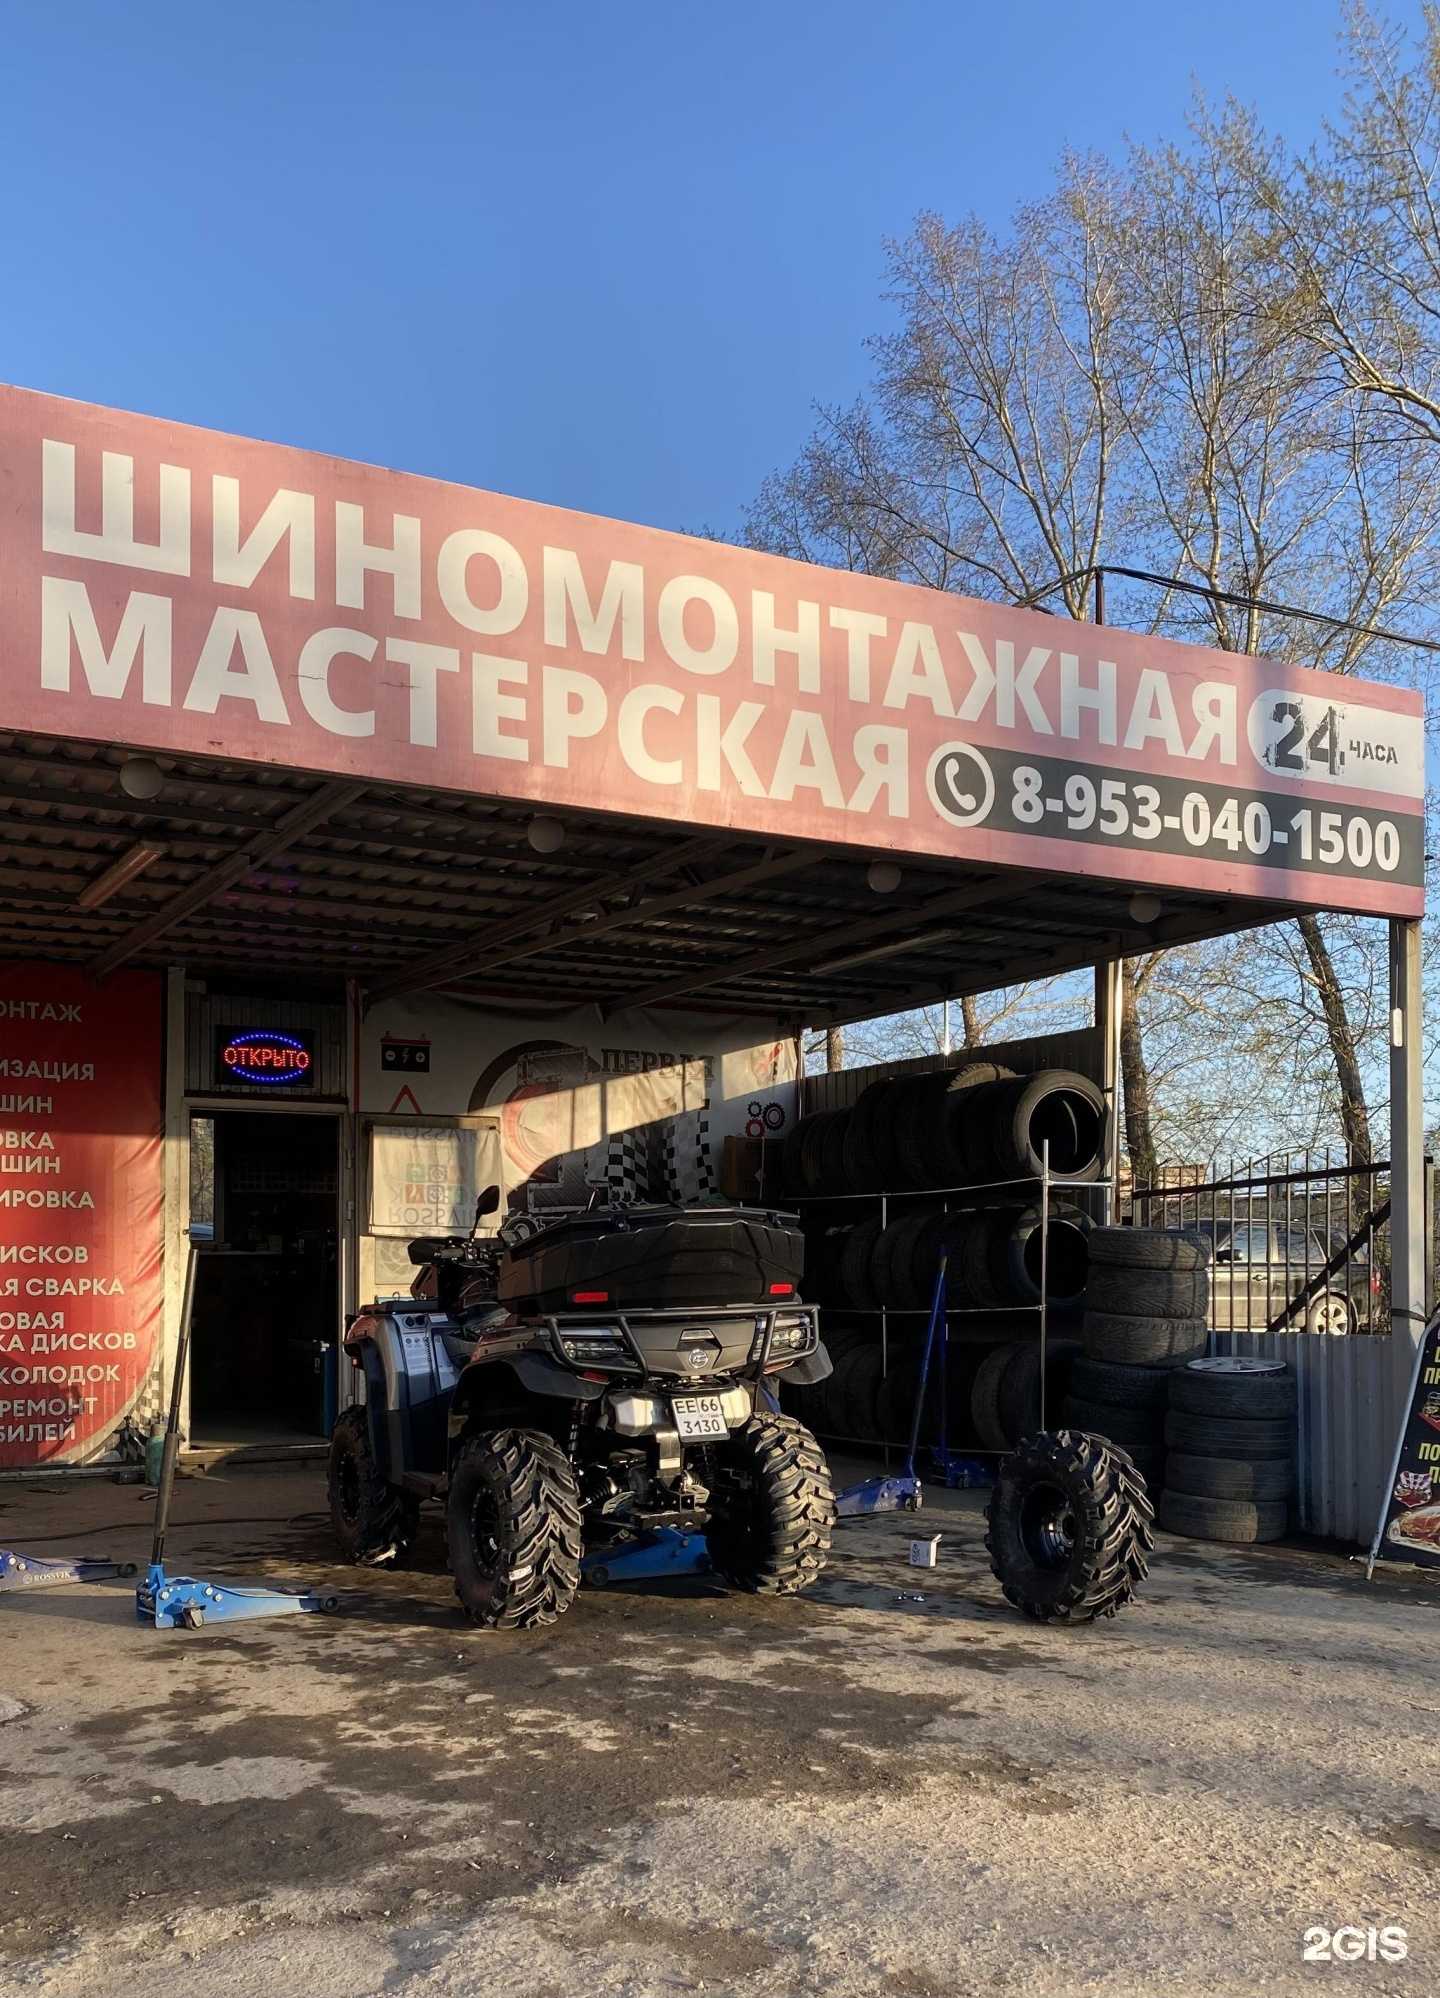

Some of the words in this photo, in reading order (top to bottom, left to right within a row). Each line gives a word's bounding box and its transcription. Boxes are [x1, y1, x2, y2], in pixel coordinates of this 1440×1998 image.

[42, 438, 1237, 766] ШИНОМОНТАЖНАЯ
[41, 574, 909, 819] МАСТЕРСКАЯ
[1273, 698, 1345, 776] 24
[1349, 739, 1399, 765] ЧАСА
[1011, 765, 1401, 872] 8-953-040-1500
[223, 1047, 310, 1069] ОТКРЫТО
[0, 1130, 54, 1150] ВКА
[1, 1154, 61, 1174] ШИН
[0, 1245, 89, 1264] ИСКОВ
[0, 1278, 19, 1297] Я
[25, 1277, 125, 1296] СВАРКА
[0, 1311, 65, 1330] ОВАЯ
[30, 1332, 137, 1355] ДИСКОВ
[0, 1396, 99, 1417] РЕМОНТ
[700, 1399, 718, 1412] 66
[683, 1418, 720, 1434] 3130
